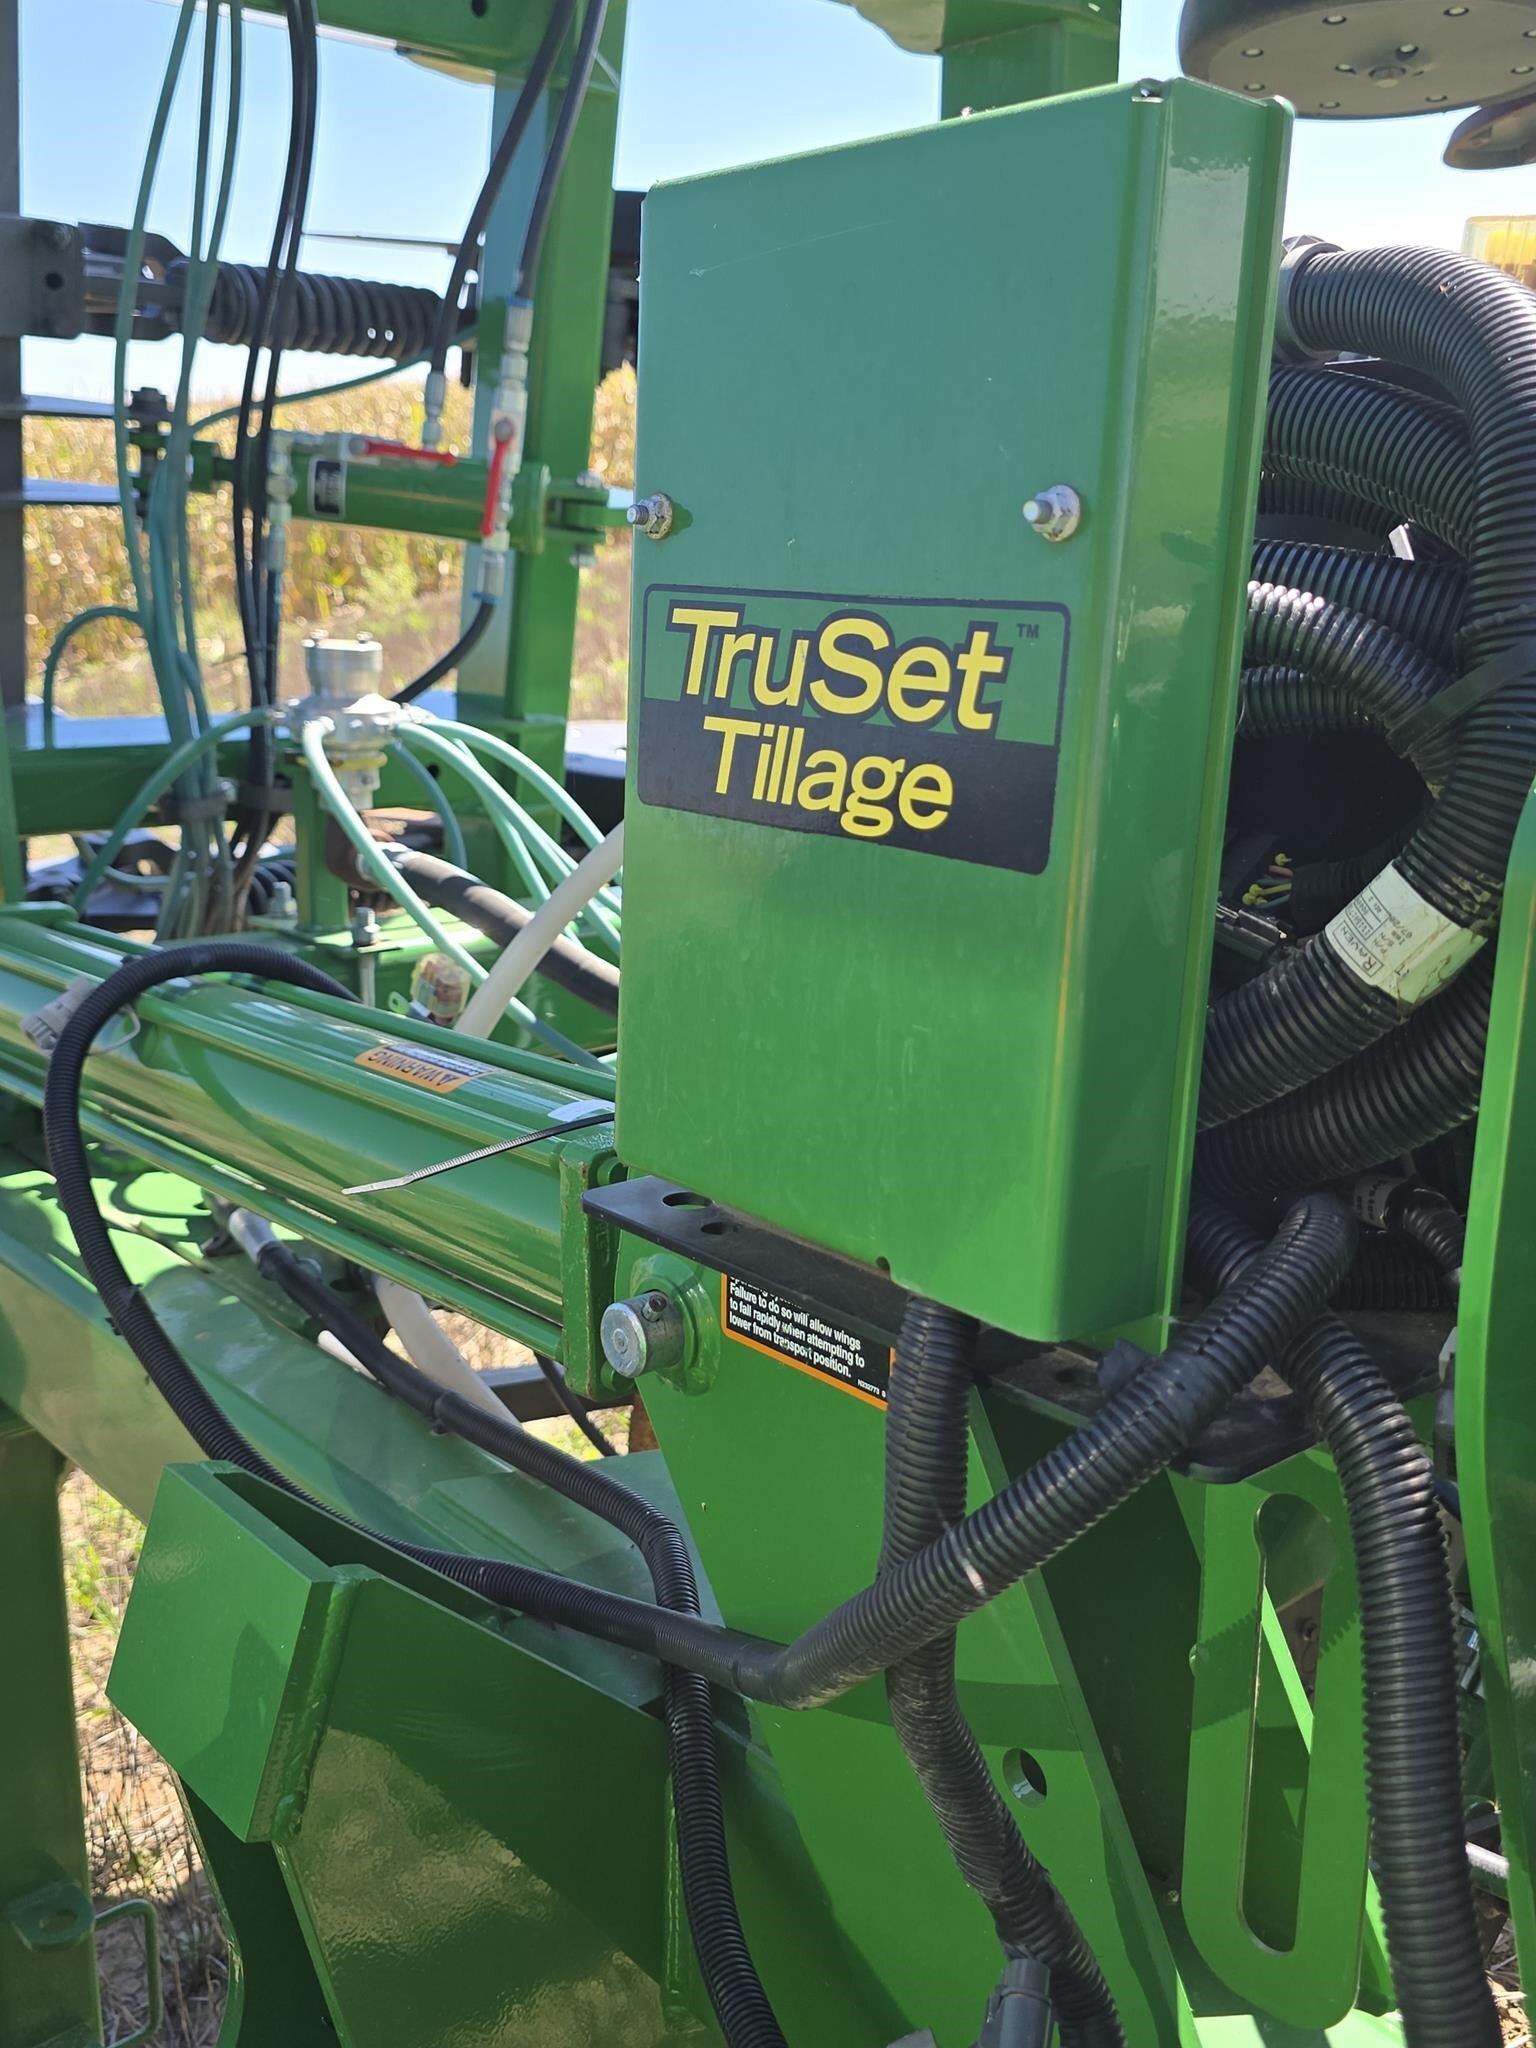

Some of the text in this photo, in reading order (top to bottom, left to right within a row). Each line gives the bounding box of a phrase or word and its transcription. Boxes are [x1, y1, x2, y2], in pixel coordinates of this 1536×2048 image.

[672, 607, 1006, 731] TruSet
[703, 716, 954, 838] Tillage
[368, 1051, 441, 1082] WARNING
[729, 1312, 751, 1331] lower
[752, 1322, 772, 1341] from
[814, 1351, 851, 1378] position.
[730, 1282, 757, 1304] Failure
[758, 1294, 766, 1308] to
[768, 1299, 779, 1314] do
[781, 1307, 792, 1319] so
[794, 1312, 809, 1327] will
[810, 1318, 832, 1336] allow
[834, 1330, 861, 1350] wings
[730, 1297, 865, 1368] to fall rapidly when attempting to
